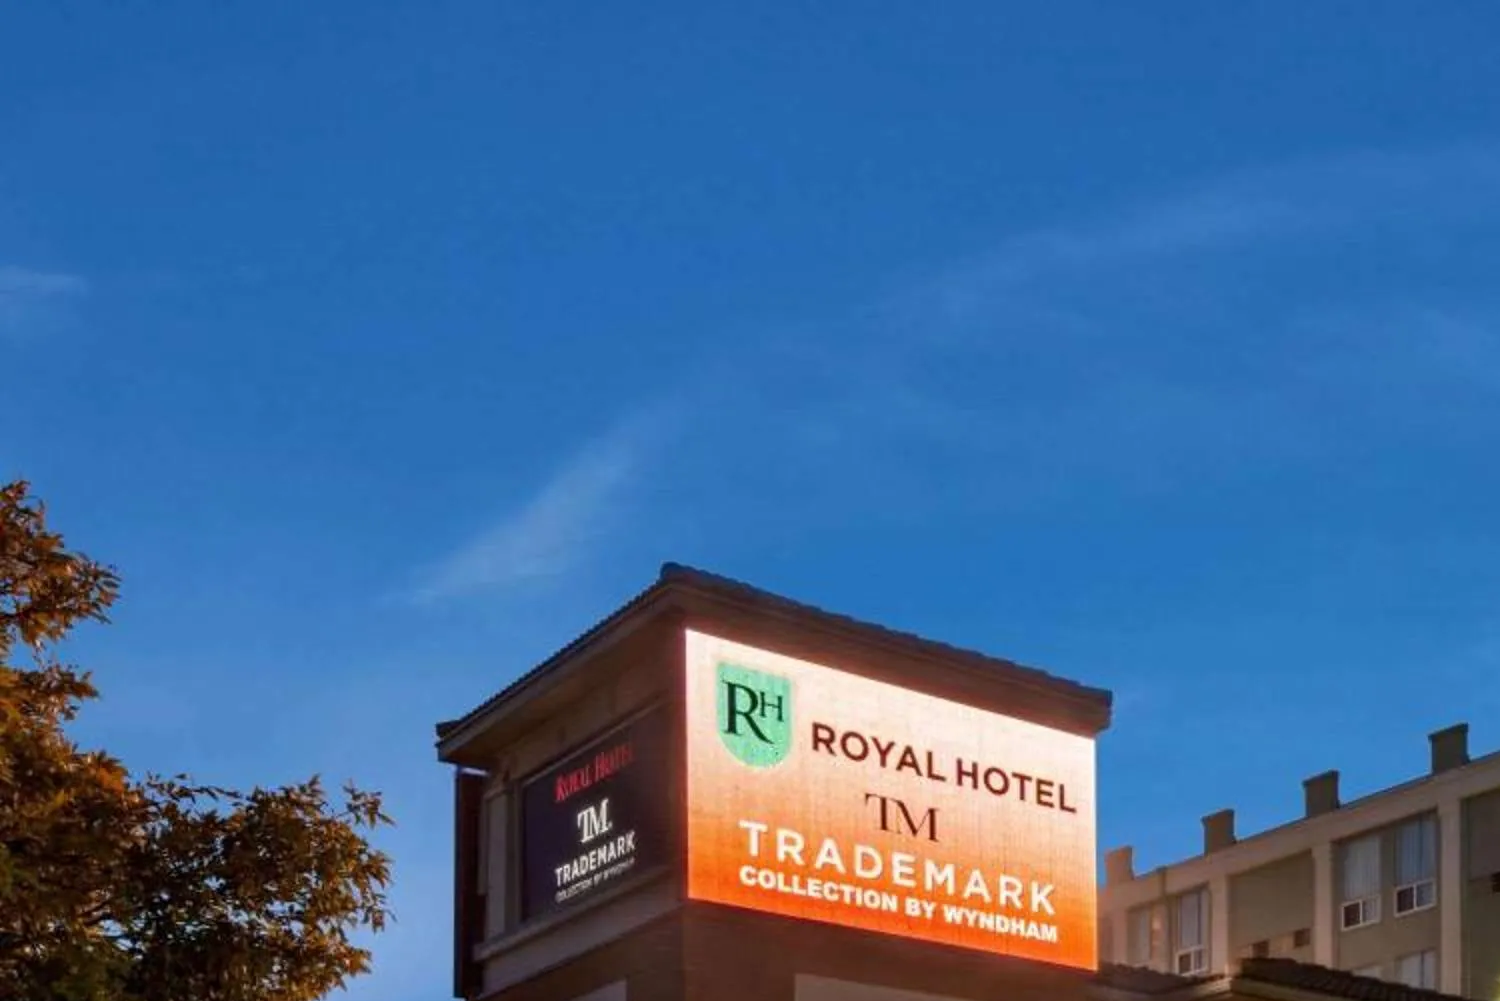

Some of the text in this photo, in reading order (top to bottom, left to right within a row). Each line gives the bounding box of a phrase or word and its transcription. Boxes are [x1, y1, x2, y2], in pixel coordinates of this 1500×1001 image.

[811, 721, 1077, 814] ROYAL HOTEL
[865, 793, 940, 842] TM
[554, 830, 636, 887] TRADEMARK
[738, 820, 1056, 916] TRADEMARK
[739, 865, 1058, 943] COLLECTION BY WYNDHAM
